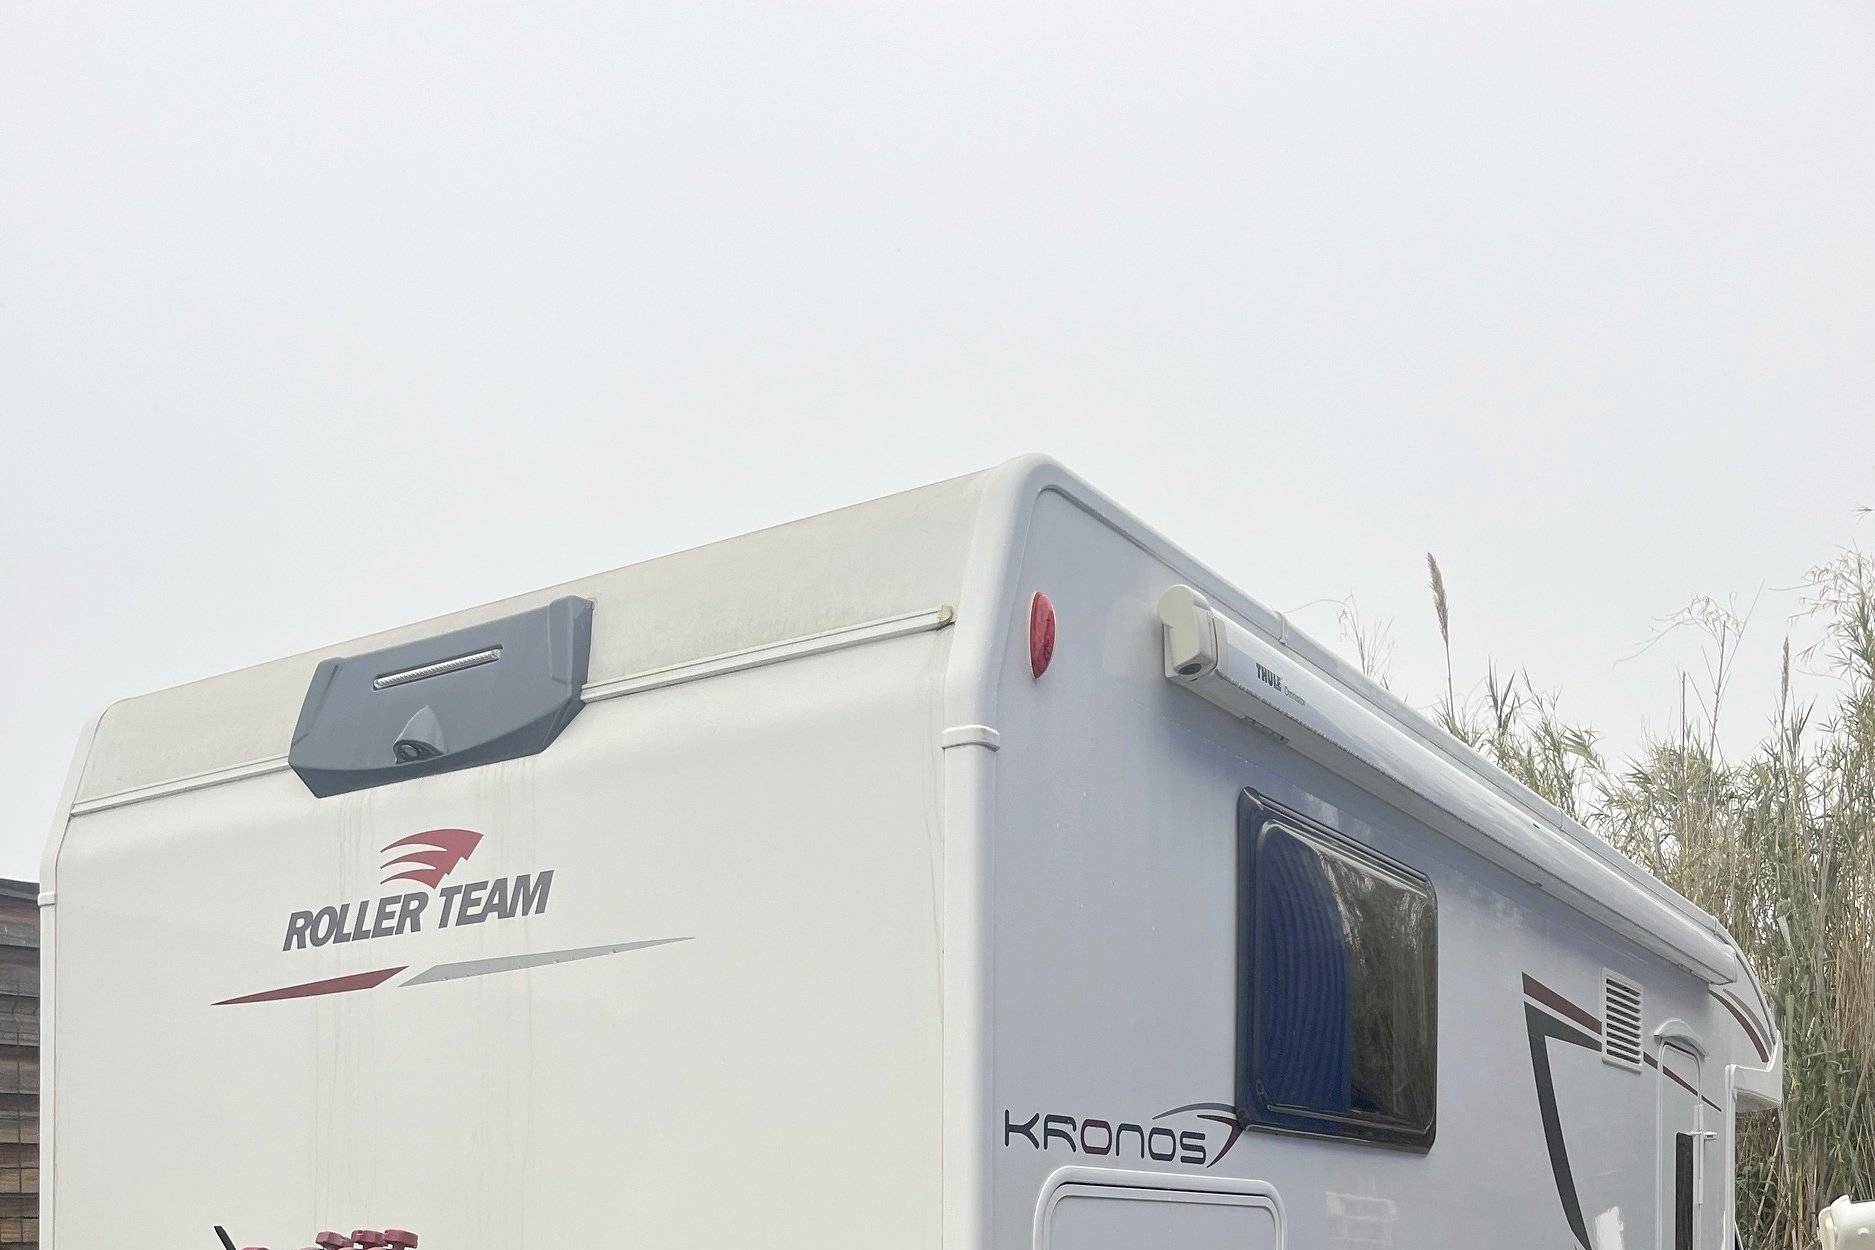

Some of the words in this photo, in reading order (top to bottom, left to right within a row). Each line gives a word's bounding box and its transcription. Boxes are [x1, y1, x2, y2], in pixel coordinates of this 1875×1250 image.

[1256, 662, 1282, 692] THULE
[283, 891, 430, 951] ROLLER
[438, 870, 554, 928] TEAM
